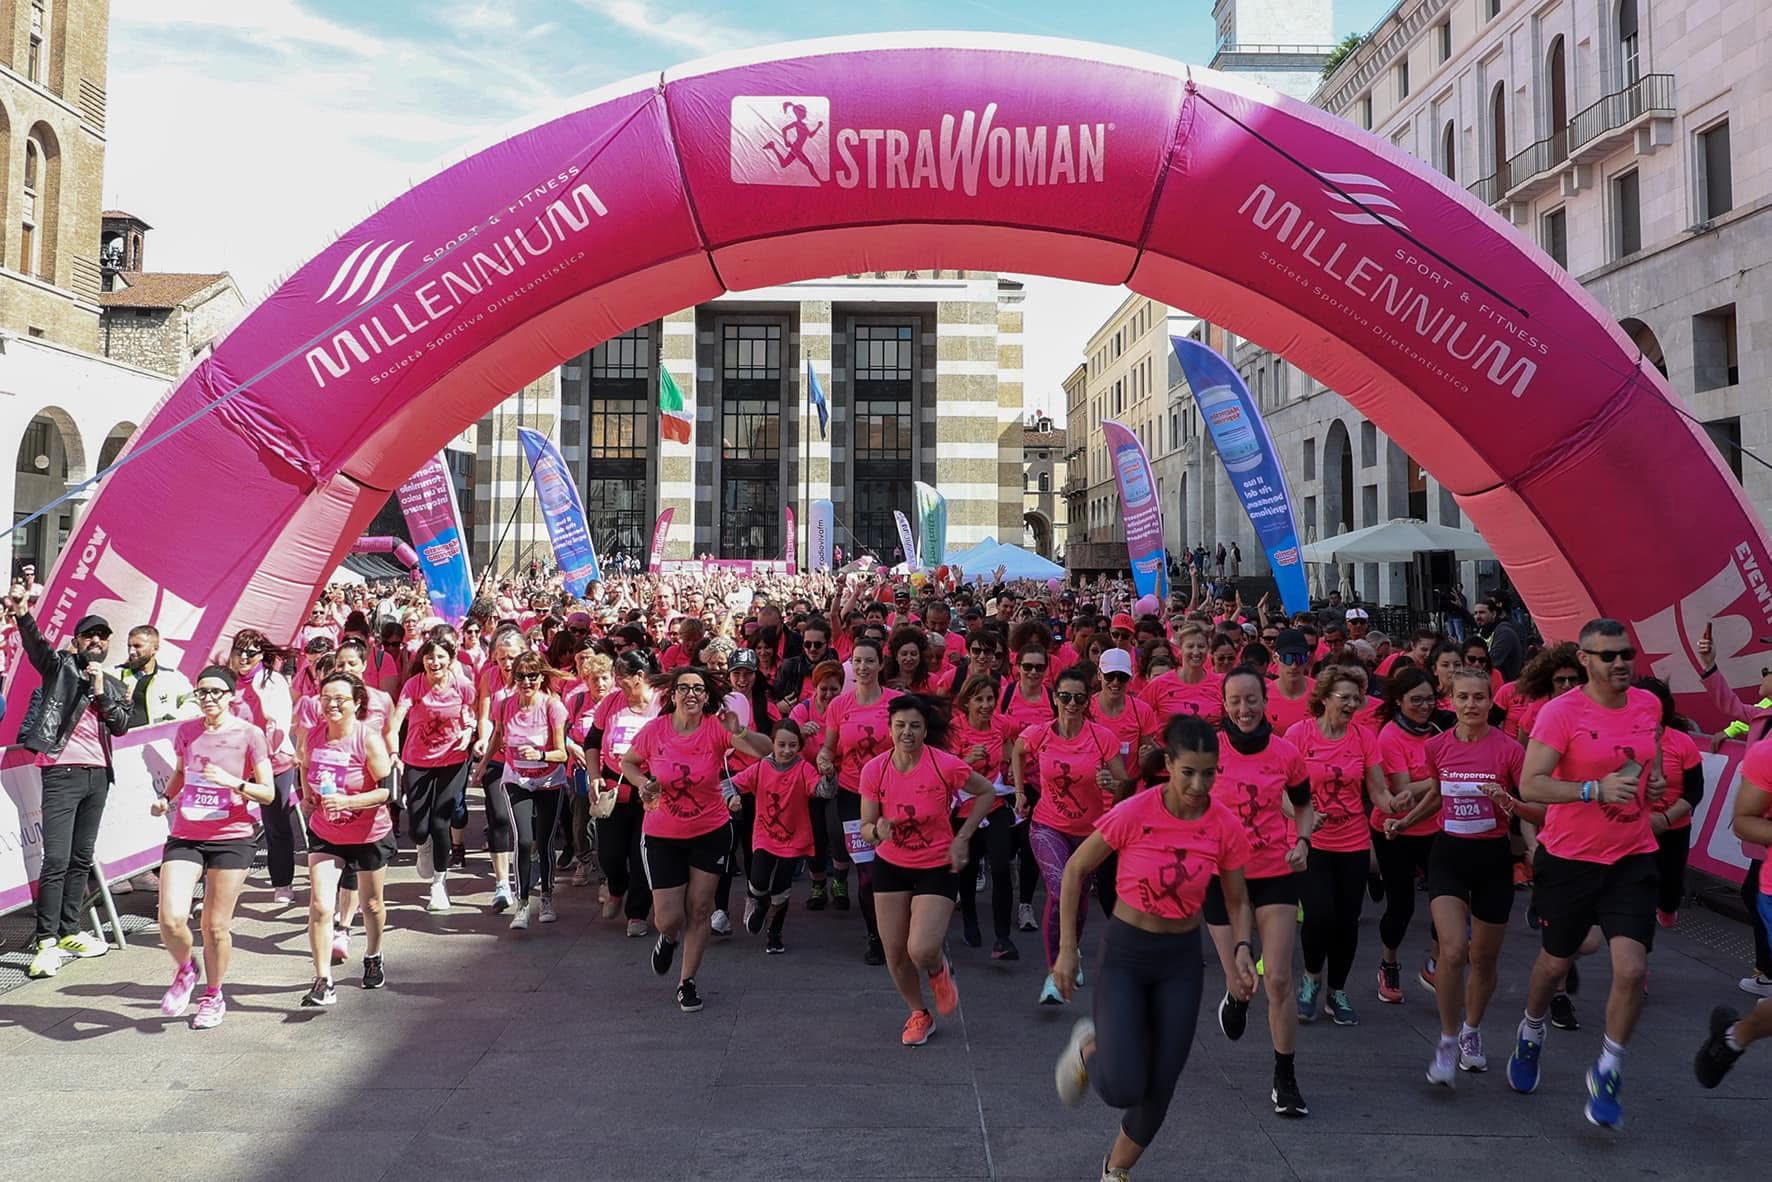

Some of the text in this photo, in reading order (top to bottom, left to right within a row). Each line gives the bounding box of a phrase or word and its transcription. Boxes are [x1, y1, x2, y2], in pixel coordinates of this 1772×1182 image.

[836, 103, 1105, 196] STRAWOMAN
[423, 226, 479, 264] SPORT
[508, 166, 580, 213] FITNESS
[305, 183, 609, 388] MILLENNIUM
[370, 251, 585, 385] Società Sportiva Dilettantistica
[1238, 184, 1538, 398] MILLENNIUM
[1258, 250, 1470, 393] Società Sportiva Dilettantistica
[1394, 248, 1550, 355] SPORT & FITNESS
[44, 524, 107, 643] ENTI WOW
[195, 794, 219, 805] 2024
[852, 839, 871, 848] 202
[1454, 804, 1480, 816] 2024
